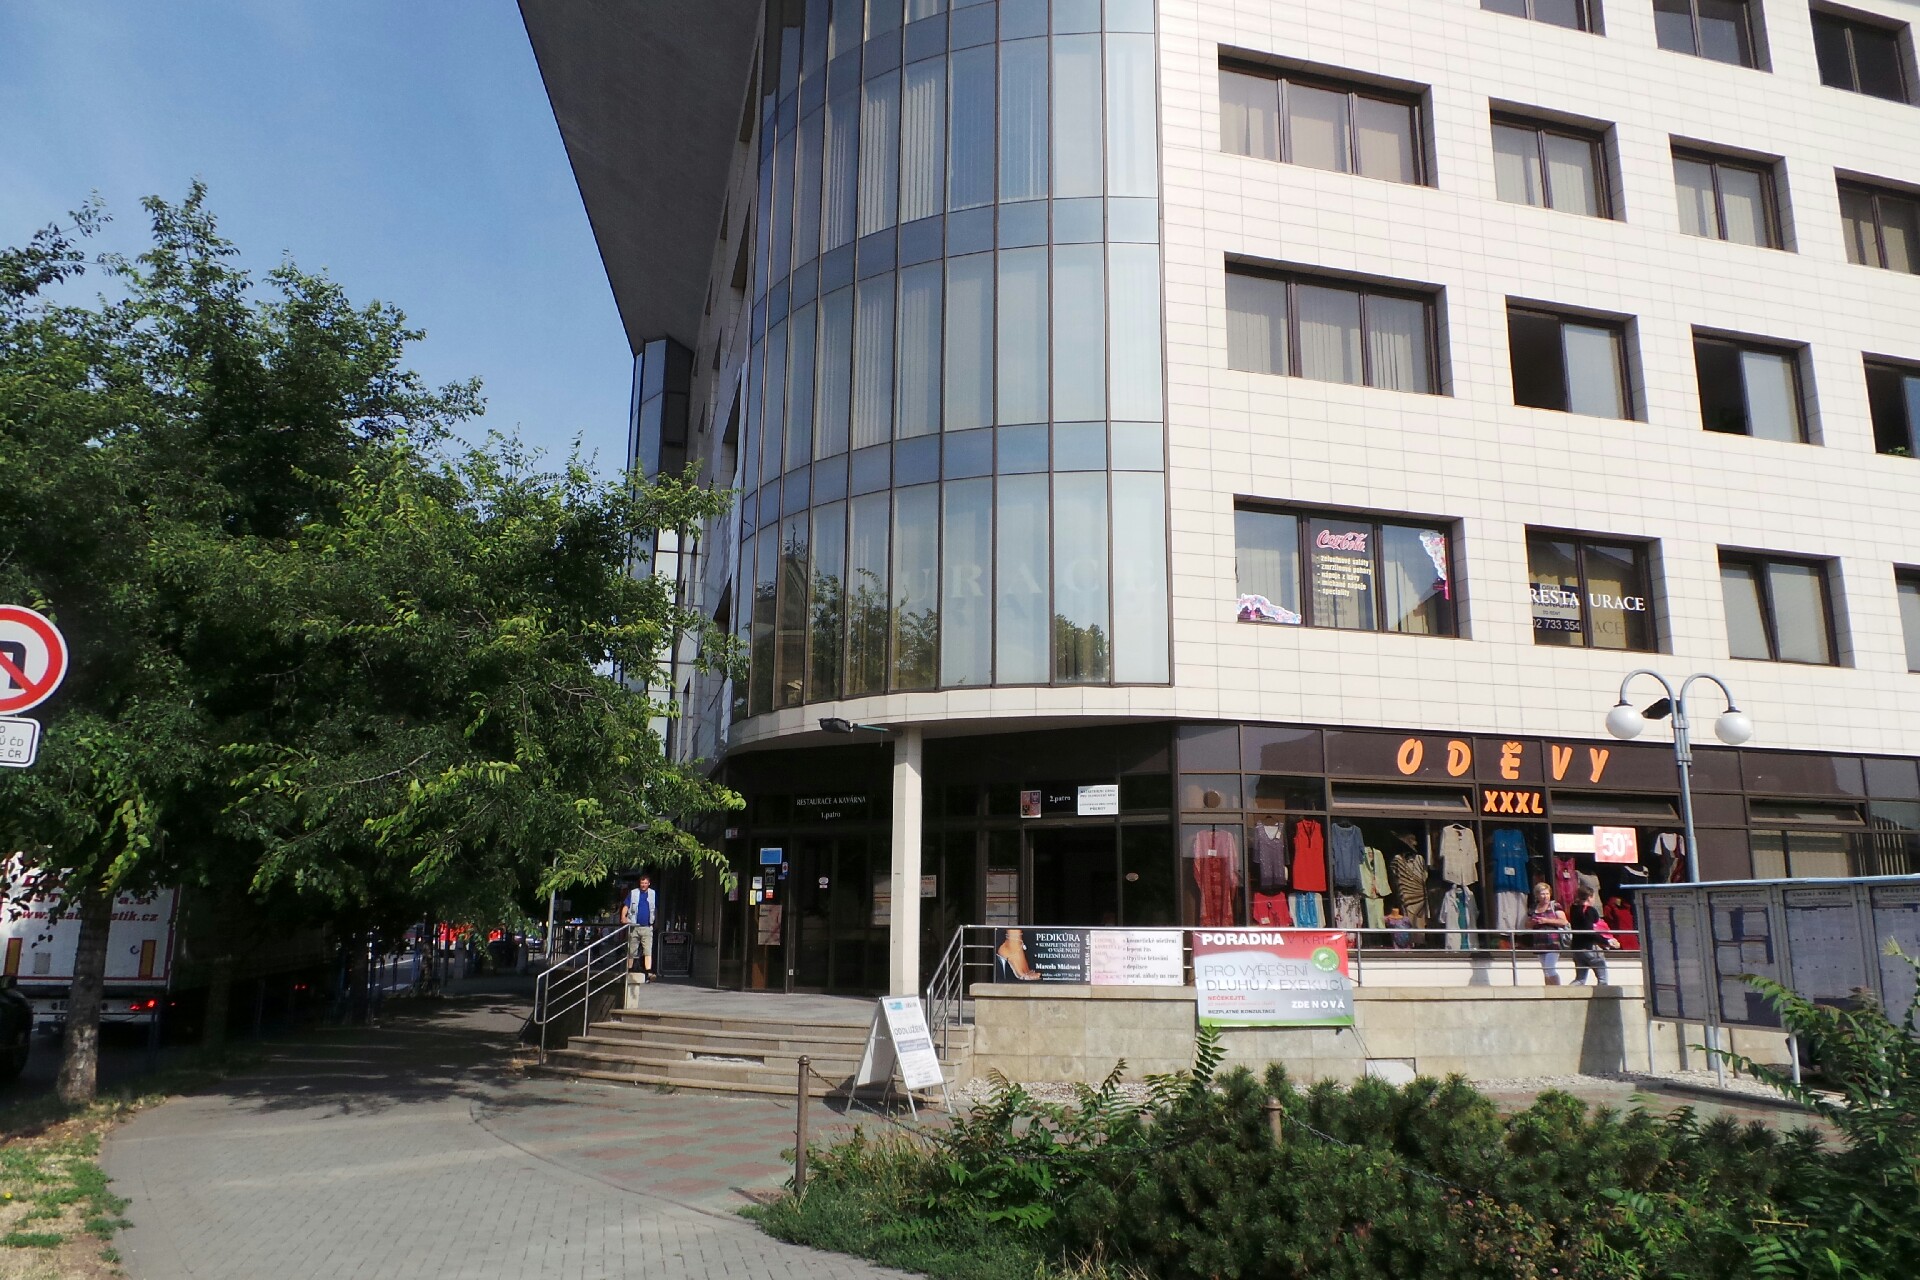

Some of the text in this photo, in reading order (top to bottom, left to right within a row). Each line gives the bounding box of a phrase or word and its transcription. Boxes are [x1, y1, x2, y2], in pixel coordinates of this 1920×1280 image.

[1316, 529, 1368, 552] Coca-Cola
[1589, 593, 1646, 611] URACE
[1545, 619, 1562, 630] 733
[1564, 620, 1580, 631] 354
[10, 736, 24, 747] ČD
[8, 748, 22, 759] ČR
[1397, 738, 1609, 783] ODĚVY
[796, 798, 832, 806] RESTAURACE
[1484, 790, 1543, 814] XXXL
[1202, 933, 1284, 945] PORADNA
[1204, 965, 1235, 977] PRO
[1239, 962, 1308, 977] VYŘEŠENÍ
[1280, 977, 1344, 991] EXEKUCÍ
